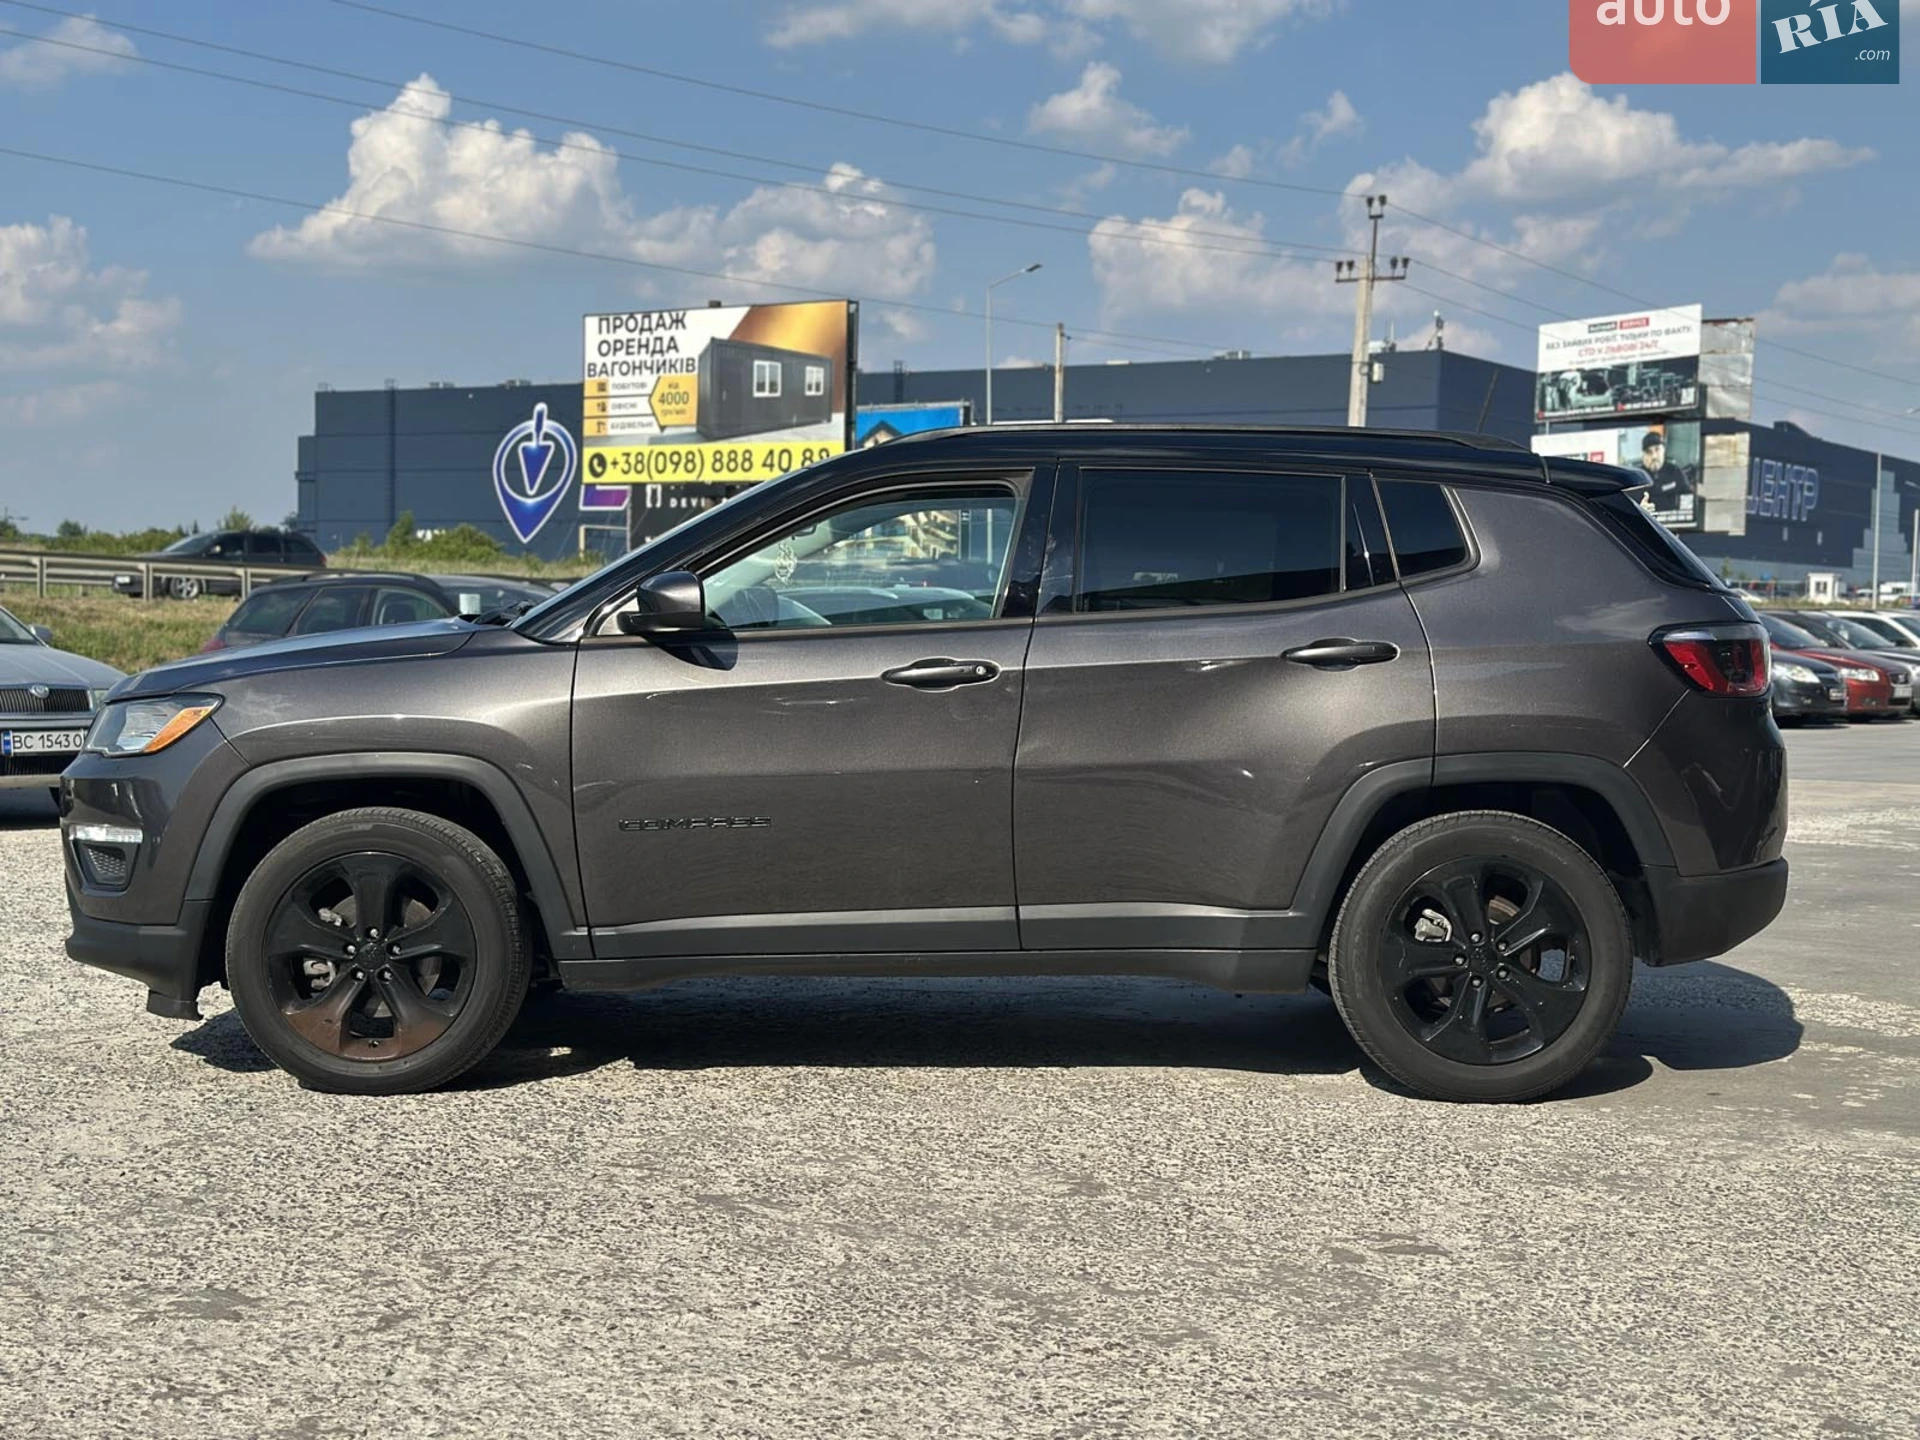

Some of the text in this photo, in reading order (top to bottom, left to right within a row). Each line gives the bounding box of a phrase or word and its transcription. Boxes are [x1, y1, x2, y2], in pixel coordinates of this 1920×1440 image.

[598, 311, 687, 335] ПРОДАЖ
[1651, 329, 1662, 338] ПО
[597, 335, 679, 357] ОРЕНДА
[1577, 346, 1596, 358] СТО
[587, 357, 696, 378] ВАГОНЧИКІВ
[658, 391, 690, 406] 4000
[610, 448, 705, 481] +38(098)
[711, 449, 754, 473] 888
[761, 448, 793, 473] 40
[12, 734, 34, 749] BC
[38, 734, 71, 749] 1543
[618, 816, 772, 831] COMPASS
